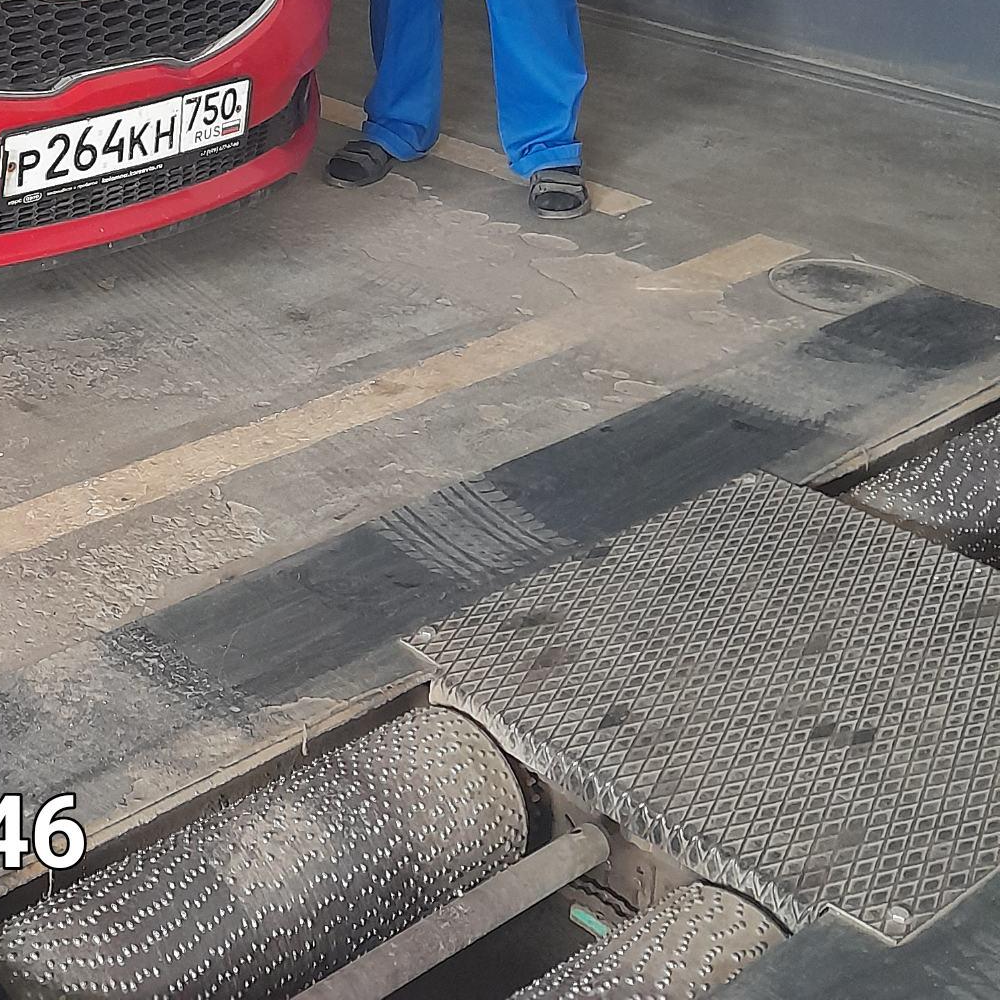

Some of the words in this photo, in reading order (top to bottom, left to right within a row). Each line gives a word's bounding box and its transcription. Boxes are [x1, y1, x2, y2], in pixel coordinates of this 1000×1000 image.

[16, 115, 178, 188] Р264КН
[185, 87, 238, 133] 750
[194, 125, 221, 143] RUS
